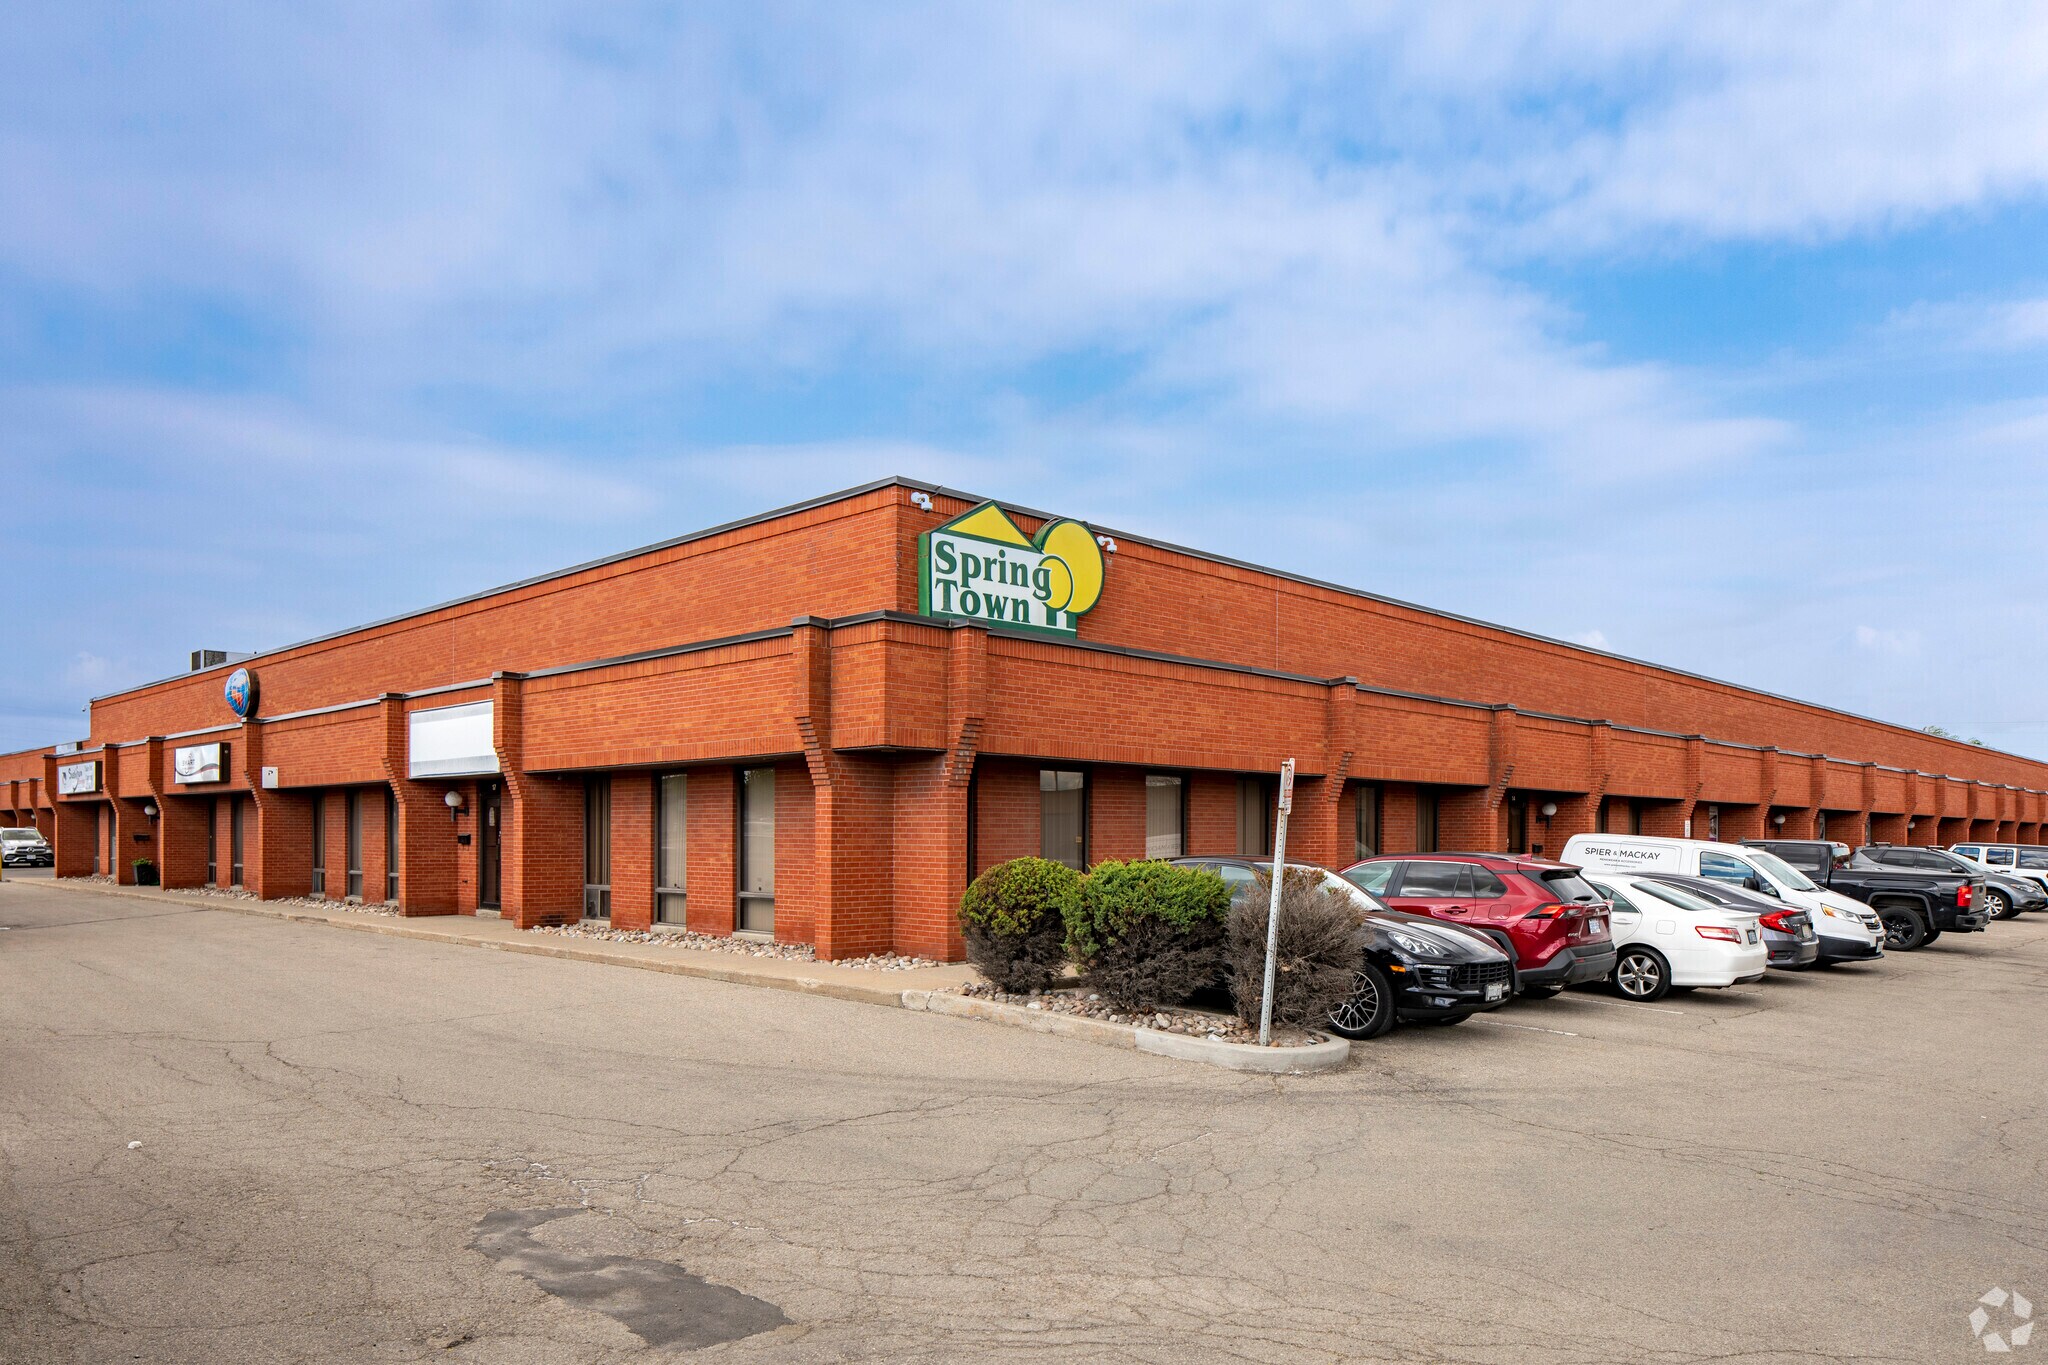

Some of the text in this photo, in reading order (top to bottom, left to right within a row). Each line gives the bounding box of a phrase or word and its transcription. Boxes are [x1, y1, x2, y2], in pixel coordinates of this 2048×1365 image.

[935, 540, 1053, 601] Spring
[935, 577, 1031, 624] Town
[1585, 847, 1611, 856] SPIER
[1619, 850, 1661, 860] MACKAY
